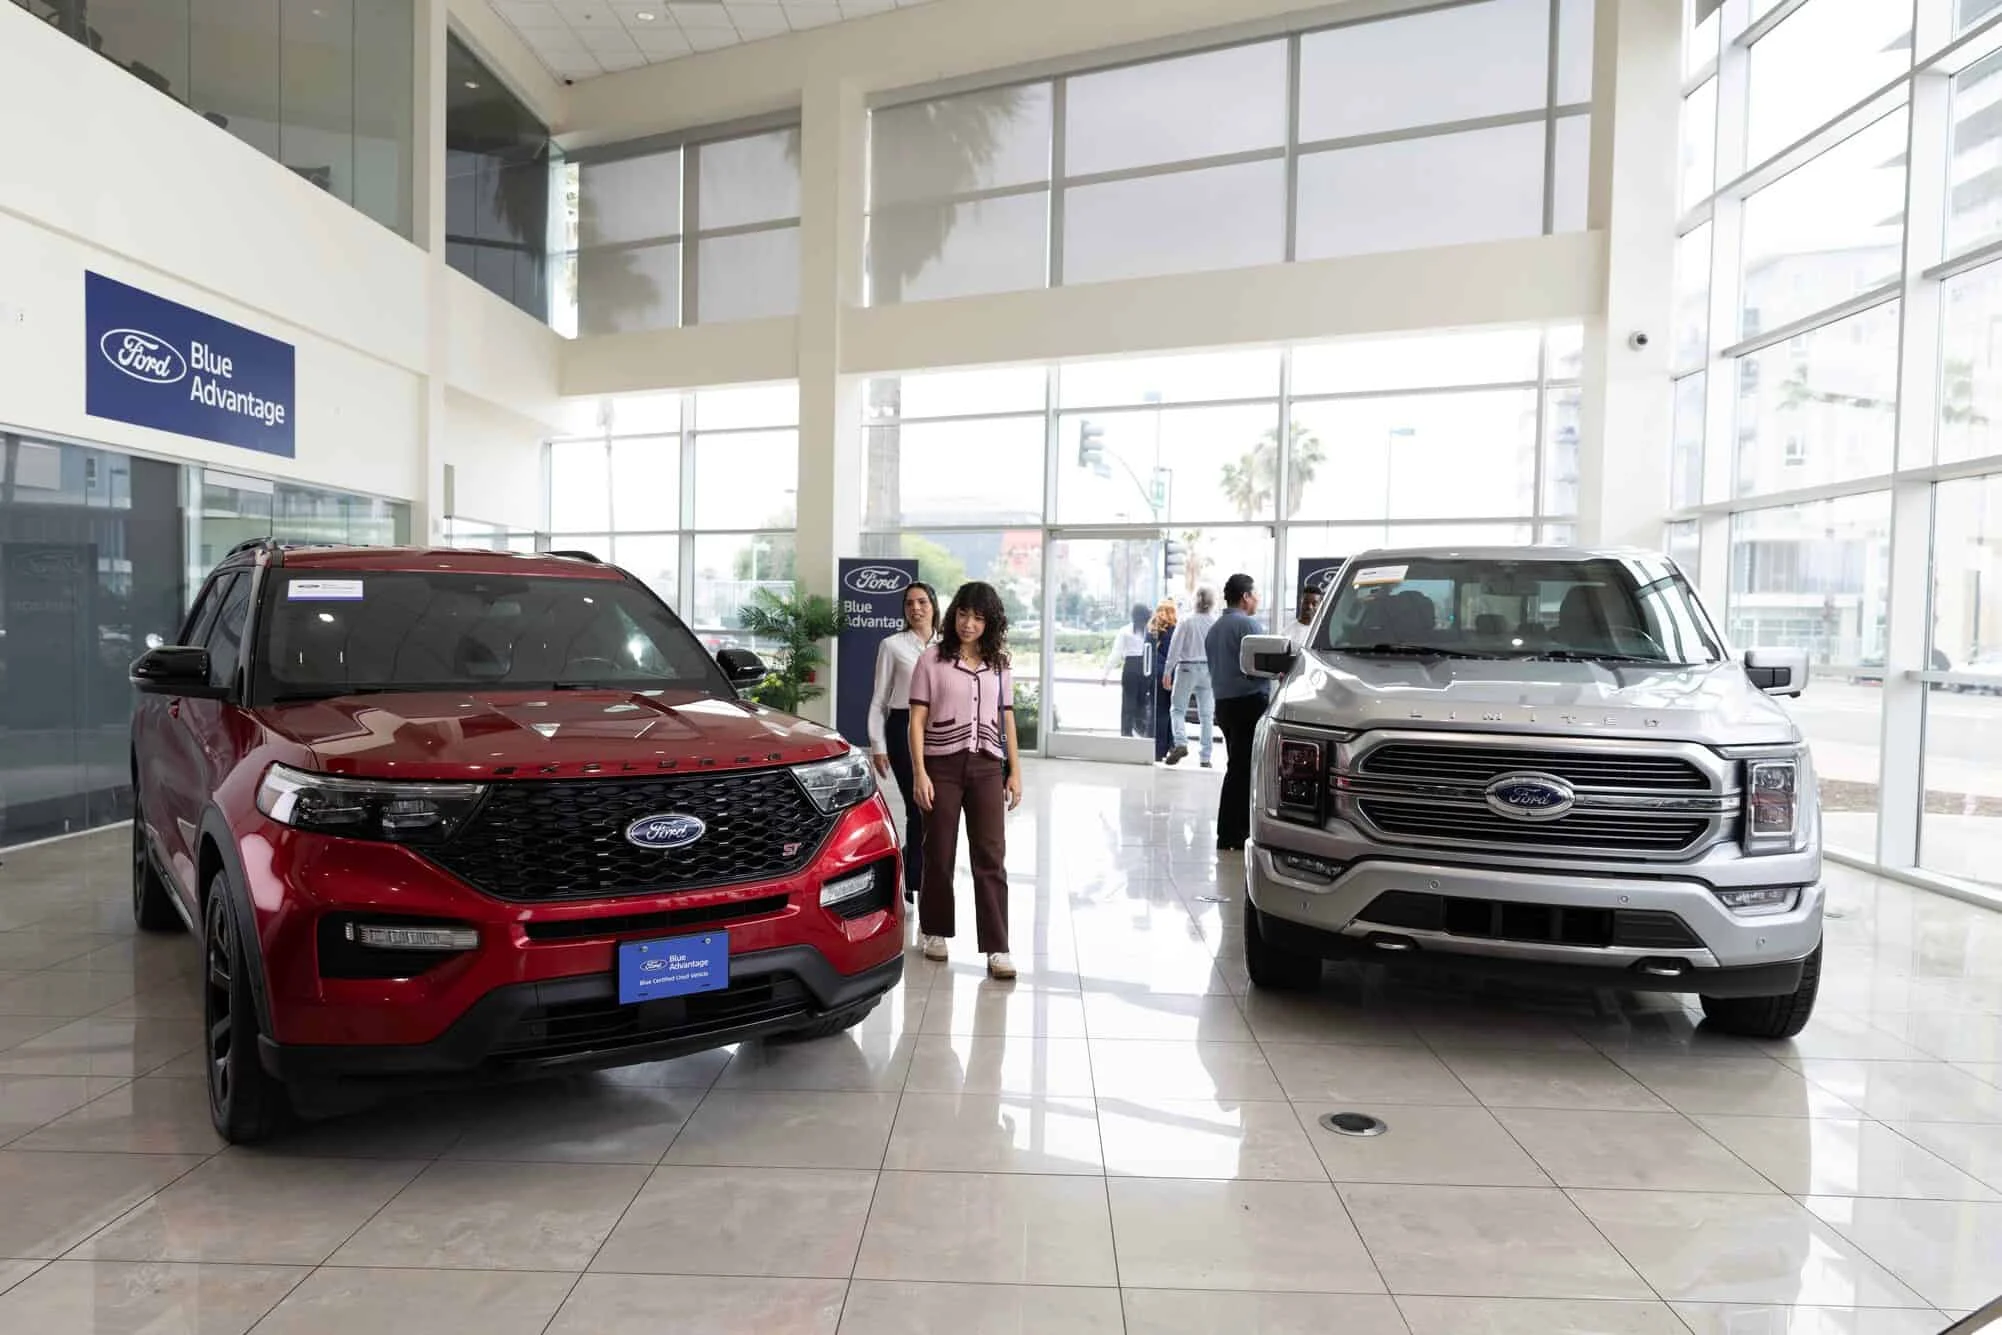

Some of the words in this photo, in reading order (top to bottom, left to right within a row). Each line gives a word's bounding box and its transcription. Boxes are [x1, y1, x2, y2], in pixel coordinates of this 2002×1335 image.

[118, 335, 171, 377] Ford
[190, 341, 232, 378] Blue
[190, 375, 285, 426] Advantage
[856, 570, 900, 589] Ford
[844, 600, 873, 613] Blue
[845, 615, 904, 631] dvantag
[1508, 788, 1551, 804] Ford
[646, 821, 688, 840] Ford
[782, 842, 802, 857] ST
